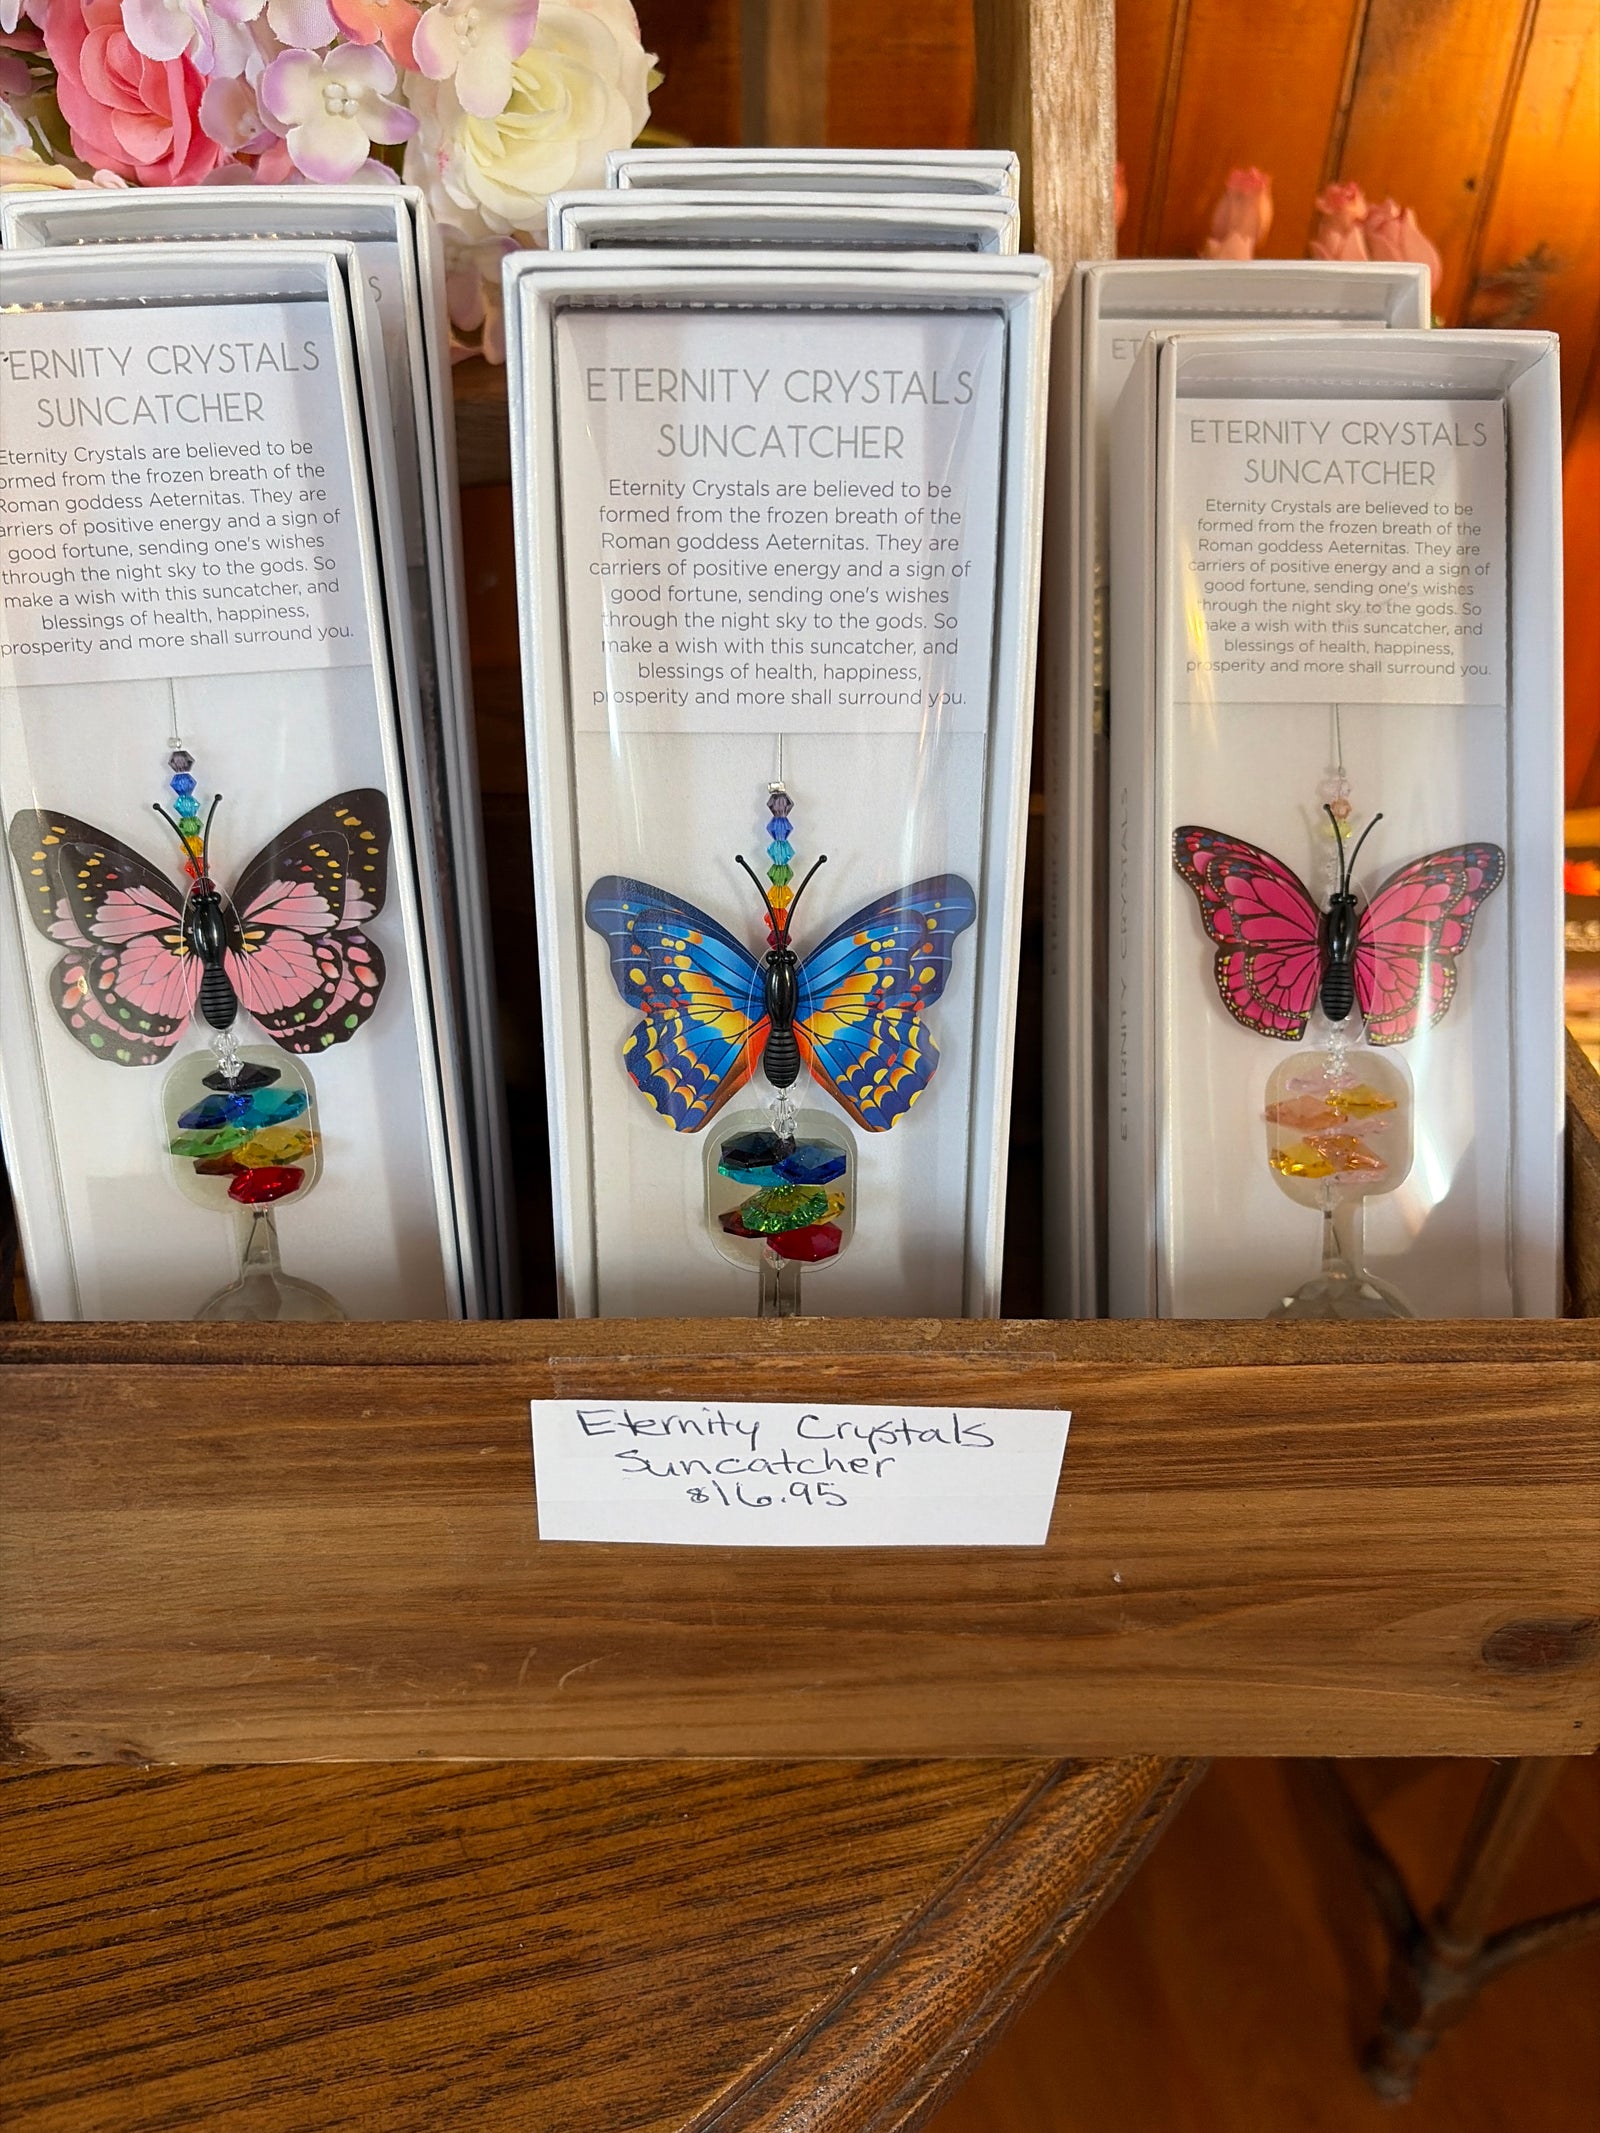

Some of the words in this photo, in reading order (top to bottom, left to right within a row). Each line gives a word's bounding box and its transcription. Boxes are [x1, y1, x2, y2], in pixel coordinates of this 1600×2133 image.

[147, 340, 319, 374] CRYSTALS
[586, 367, 769, 402] ETERNITY
[784, 368, 973, 404] CRYSTALS
[37, 391, 264, 428] SUNCATCHER
[656, 423, 904, 459] SUNCATCHER
[1190, 419, 1330, 444] ETERNITY
[1341, 420, 1487, 446] CRYSTALS
[74, 444, 146, 464] Crystals
[152, 447, 180, 459] are
[185, 440, 260, 458] believed
[290, 439, 312, 454] be
[61, 470, 105, 486] from
[110, 468, 140, 485] the
[146, 467, 203, 483] frozen
[209, 463, 267, 481] breath
[296, 462, 324, 478] the
[1244, 458, 1435, 485] SUNCATCHER
[65, 493, 142, 513] goddess
[149, 490, 244, 507] Aeternitas.
[249, 487, 292, 505] They
[299, 489, 326, 501] are
[609, 478, 685, 499] Eternity
[692, 479, 769, 499] Crystals
[776, 483, 806, 497] are
[813, 479, 893, 497] believed
[900, 481, 920, 497] to
[927, 480, 951, 498] be
[598, 505, 669, 522] formed
[676, 505, 722, 523] from
[729, 505, 760, 523] the
[766, 505, 827, 523] frozen
[835, 506, 897, 524] breath
[904, 507, 924, 524] of
[929, 507, 961, 524] the
[1205, 498, 1266, 515] Eternity
[1270, 499, 1331, 515] Crystals
[1365, 500, 1428, 515] believed
[83, 516, 153, 536] positive
[159, 517, 220, 532] energy
[227, 511, 260, 528] and
[281, 510, 317, 528] sign
[1197, 517, 1253, 532] formed
[1258, 518, 1294, 532] from
[1299, 519, 1324, 533] the
[1329, 519, 1377, 534] frozen
[1382, 520, 1431, 534] breath
[1456, 522, 1481, 535] the
[7, 543, 56, 563] good
[61, 542, 132, 558] fortune,
[138, 538, 208, 556] sending
[214, 535, 260, 552] one's
[265, 533, 324, 549] wishes
[601, 532, 669, 549] Roman
[676, 532, 759, 552] goddess
[765, 533, 868, 550] Aeternitas.
[875, 533, 922, 554] They
[928, 538, 959, 551] are
[1198, 538, 1252, 552] Roman
[1257, 539, 1323, 554] goddess
[1328, 540, 1409, 554] Aeternitas.
[1414, 541, 1451, 557] They
[1, 567, 75, 584] through
[80, 565, 110, 581] the
[116, 563, 162, 581] night
[167, 562, 196, 579] sky
[226, 559, 254, 574] the
[260, 556, 307, 576] gods.
[313, 555, 335, 570] So
[589, 558, 661, 575] carriers
[667, 558, 687, 575] of
[693, 559, 767, 578] positive
[773, 563, 840, 581] energy
[846, 560, 882, 576] and
[888, 564, 899, 576] a
[906, 560, 944, 580] sign
[951, 559, 971, 577] of
[1270, 559, 1329, 574] positive
[1333, 562, 1387, 576] energy
[1391, 561, 1420, 574] and
[1438, 561, 1469, 577] sign
[4, 591, 53, 608] make
[74, 588, 115, 605] wish
[120, 586, 159, 602] with
[164, 585, 196, 601] this
[202, 580, 301, 599] suncatcher,
[307, 577, 339, 593] and
[610, 584, 660, 604] good
[667, 584, 741, 603] fortune,
[748, 585, 822, 606] sending
[829, 586, 878, 603] one's
[885, 586, 948, 603] wishes
[1203, 578, 1244, 593] good
[1249, 578, 1309, 593] fortune,
[1313, 580, 1373, 596] sending
[1378, 581, 1417, 597] one's
[41, 612, 124, 630] blessings
[153, 607, 211, 624] health,
[217, 604, 308, 623] happiness,
[1291, 599, 1331, 615] night
[1335, 600, 1361, 616] sky
[1415, 601, 1456, 617] gods.
[684, 610, 714, 628] the
[721, 611, 769, 631] night
[775, 611, 806, 631] sky
[813, 612, 832, 628] to
[839, 611, 869, 629] the
[875, 612, 926, 632] gods.
[934, 612, 957, 629] So
[1254, 618, 1289, 632] wish
[1294, 619, 1326, 632] with
[1331, 620, 1358, 633] this
[1363, 621, 1449, 635] suncatcher,
[1453, 621, 1483, 635] and
[0, 636, 92, 657] prosperity
[99, 634, 132, 650] and
[138, 635, 184, 648] more
[190, 628, 228, 645] shall
[234, 624, 312, 643] surround
[317, 626, 353, 641] you.
[658, 640, 668, 653] a
[675, 636, 717, 653] wish
[723, 636, 763, 654] with
[770, 637, 803, 654] this
[810, 637, 916, 656] suncatcher,
[922, 637, 957, 655] and
[1224, 638, 1293, 654] blessings
[1319, 639, 1369, 654] health,
[1374, 641, 1453, 656] happiness,
[638, 661, 723, 682] blessings
[730, 662, 749, 679] of
[755, 662, 816, 681] health,
[823, 663, 921, 683] happiness,
[1270, 659, 1299, 672] and
[1303, 662, 1344, 672] more
[1348, 659, 1382, 673] shall
[1387, 661, 1455, 674] surround
[1460, 664, 1490, 677] you.
[694, 687, 729, 704] and
[736, 691, 785, 704] more
[791, 688, 831, 704] shall
[838, 688, 921, 704] surround
[928, 692, 965, 708] you.
[576, 1407, 760, 1452] Eternity
[797, 1413, 995, 1455] Crystals
[615, 1445, 896, 1478] Suncatcher
[686, 1480, 848, 1507] $16.95
